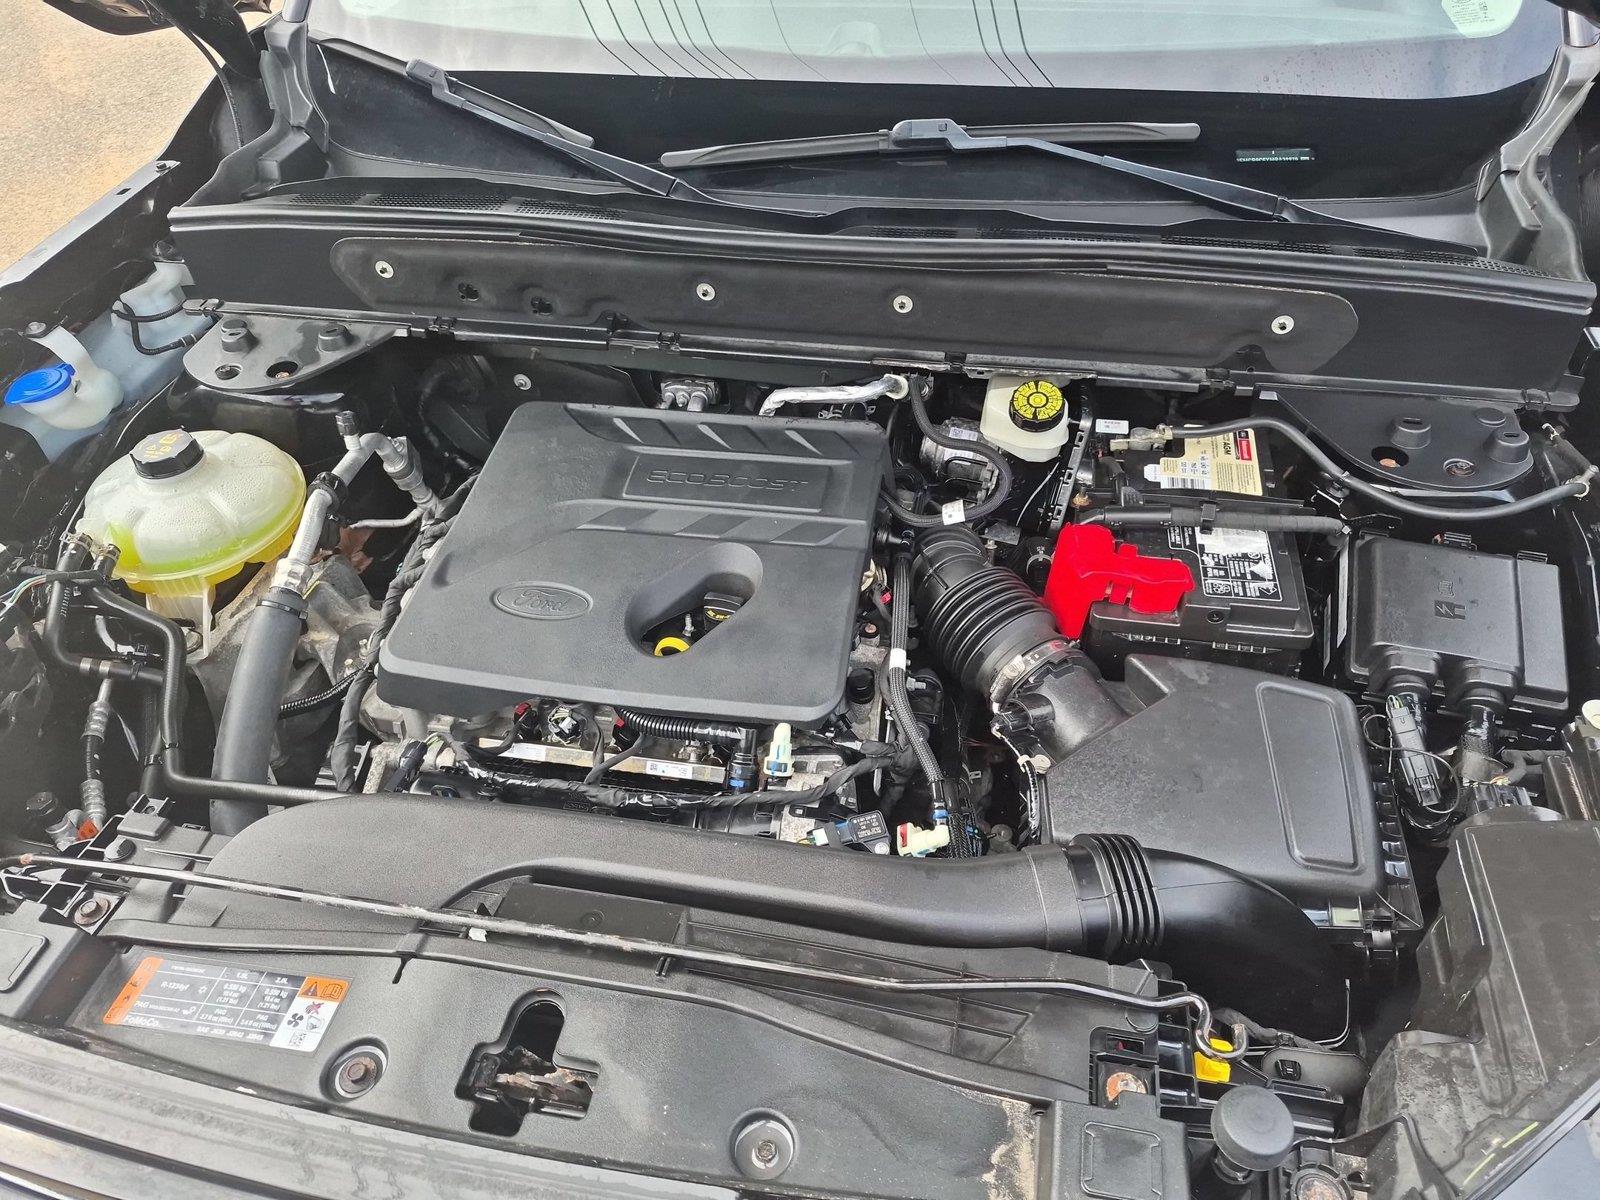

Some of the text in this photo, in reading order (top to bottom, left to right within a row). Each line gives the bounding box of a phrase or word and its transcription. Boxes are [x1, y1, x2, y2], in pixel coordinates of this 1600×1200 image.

[1222, 441, 1231, 455] AGM
[646, 469, 809, 492] ECOBOOST
[134, 1001, 150, 1009] PAG
